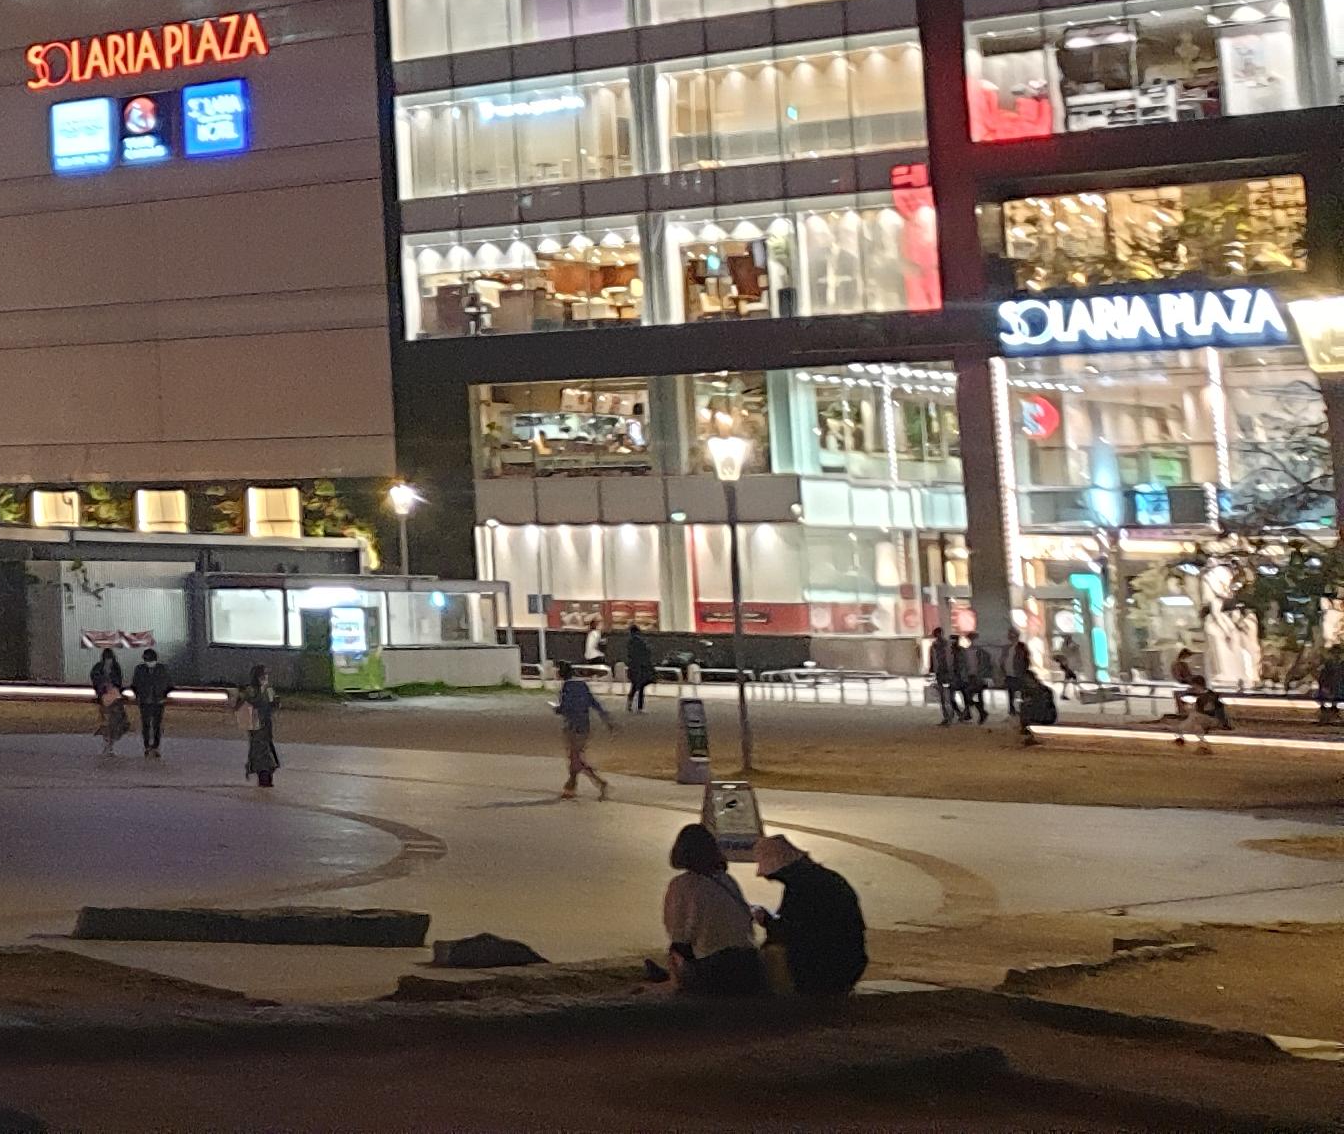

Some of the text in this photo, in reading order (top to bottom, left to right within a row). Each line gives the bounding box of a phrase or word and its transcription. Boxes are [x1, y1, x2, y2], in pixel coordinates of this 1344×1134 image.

[26, 12, 269, 89] SOLARIA PLAZA
[998, 287, 1288, 345] SOLARIA PLAZA
